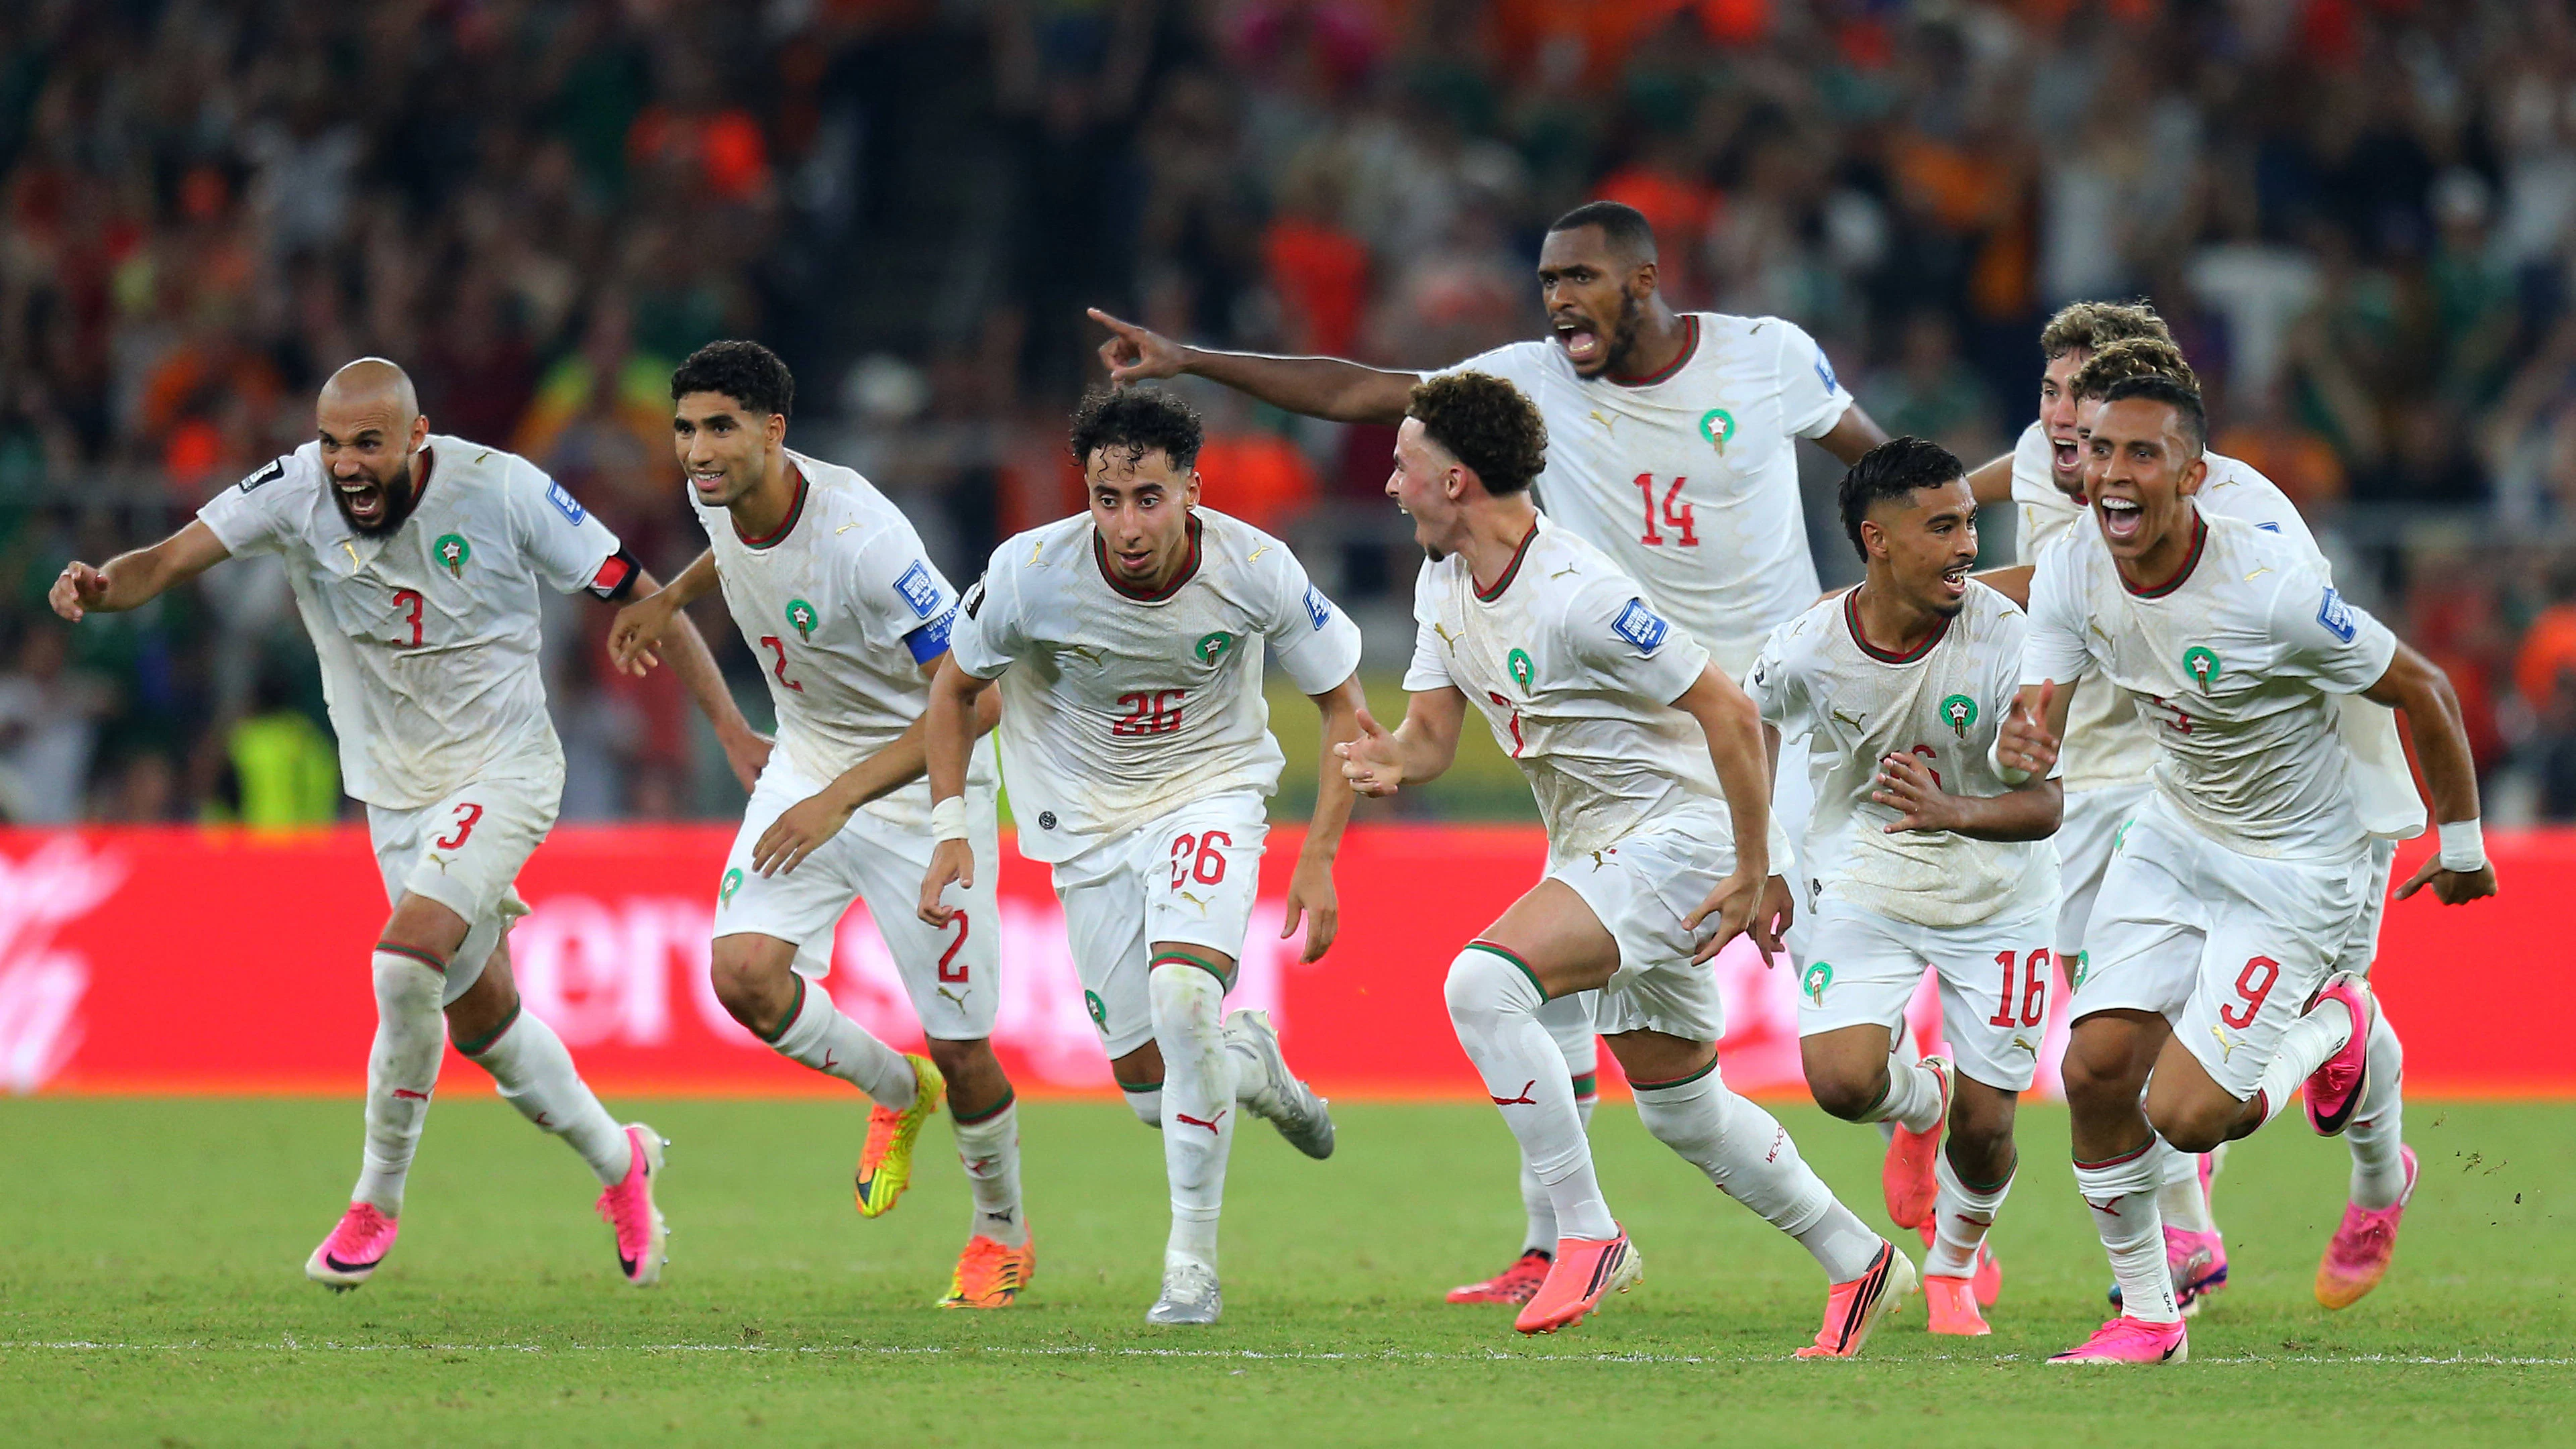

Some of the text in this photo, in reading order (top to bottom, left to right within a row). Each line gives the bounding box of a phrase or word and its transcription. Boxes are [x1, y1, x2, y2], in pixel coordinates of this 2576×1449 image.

[1633, 472, 1699, 546] 14
[392, 590, 423, 649] 3
[1627, 610, 1648, 637] UNITES
[761, 636, 804, 692] 2
[1112, 689, 1185, 736] 26
[437, 802, 482, 850] 3
[1171, 830, 1232, 894] 26
[938, 908, 969, 983] 2
[1988, 947, 2051, 1029] 16
[2220, 955, 2280, 1030] 9
